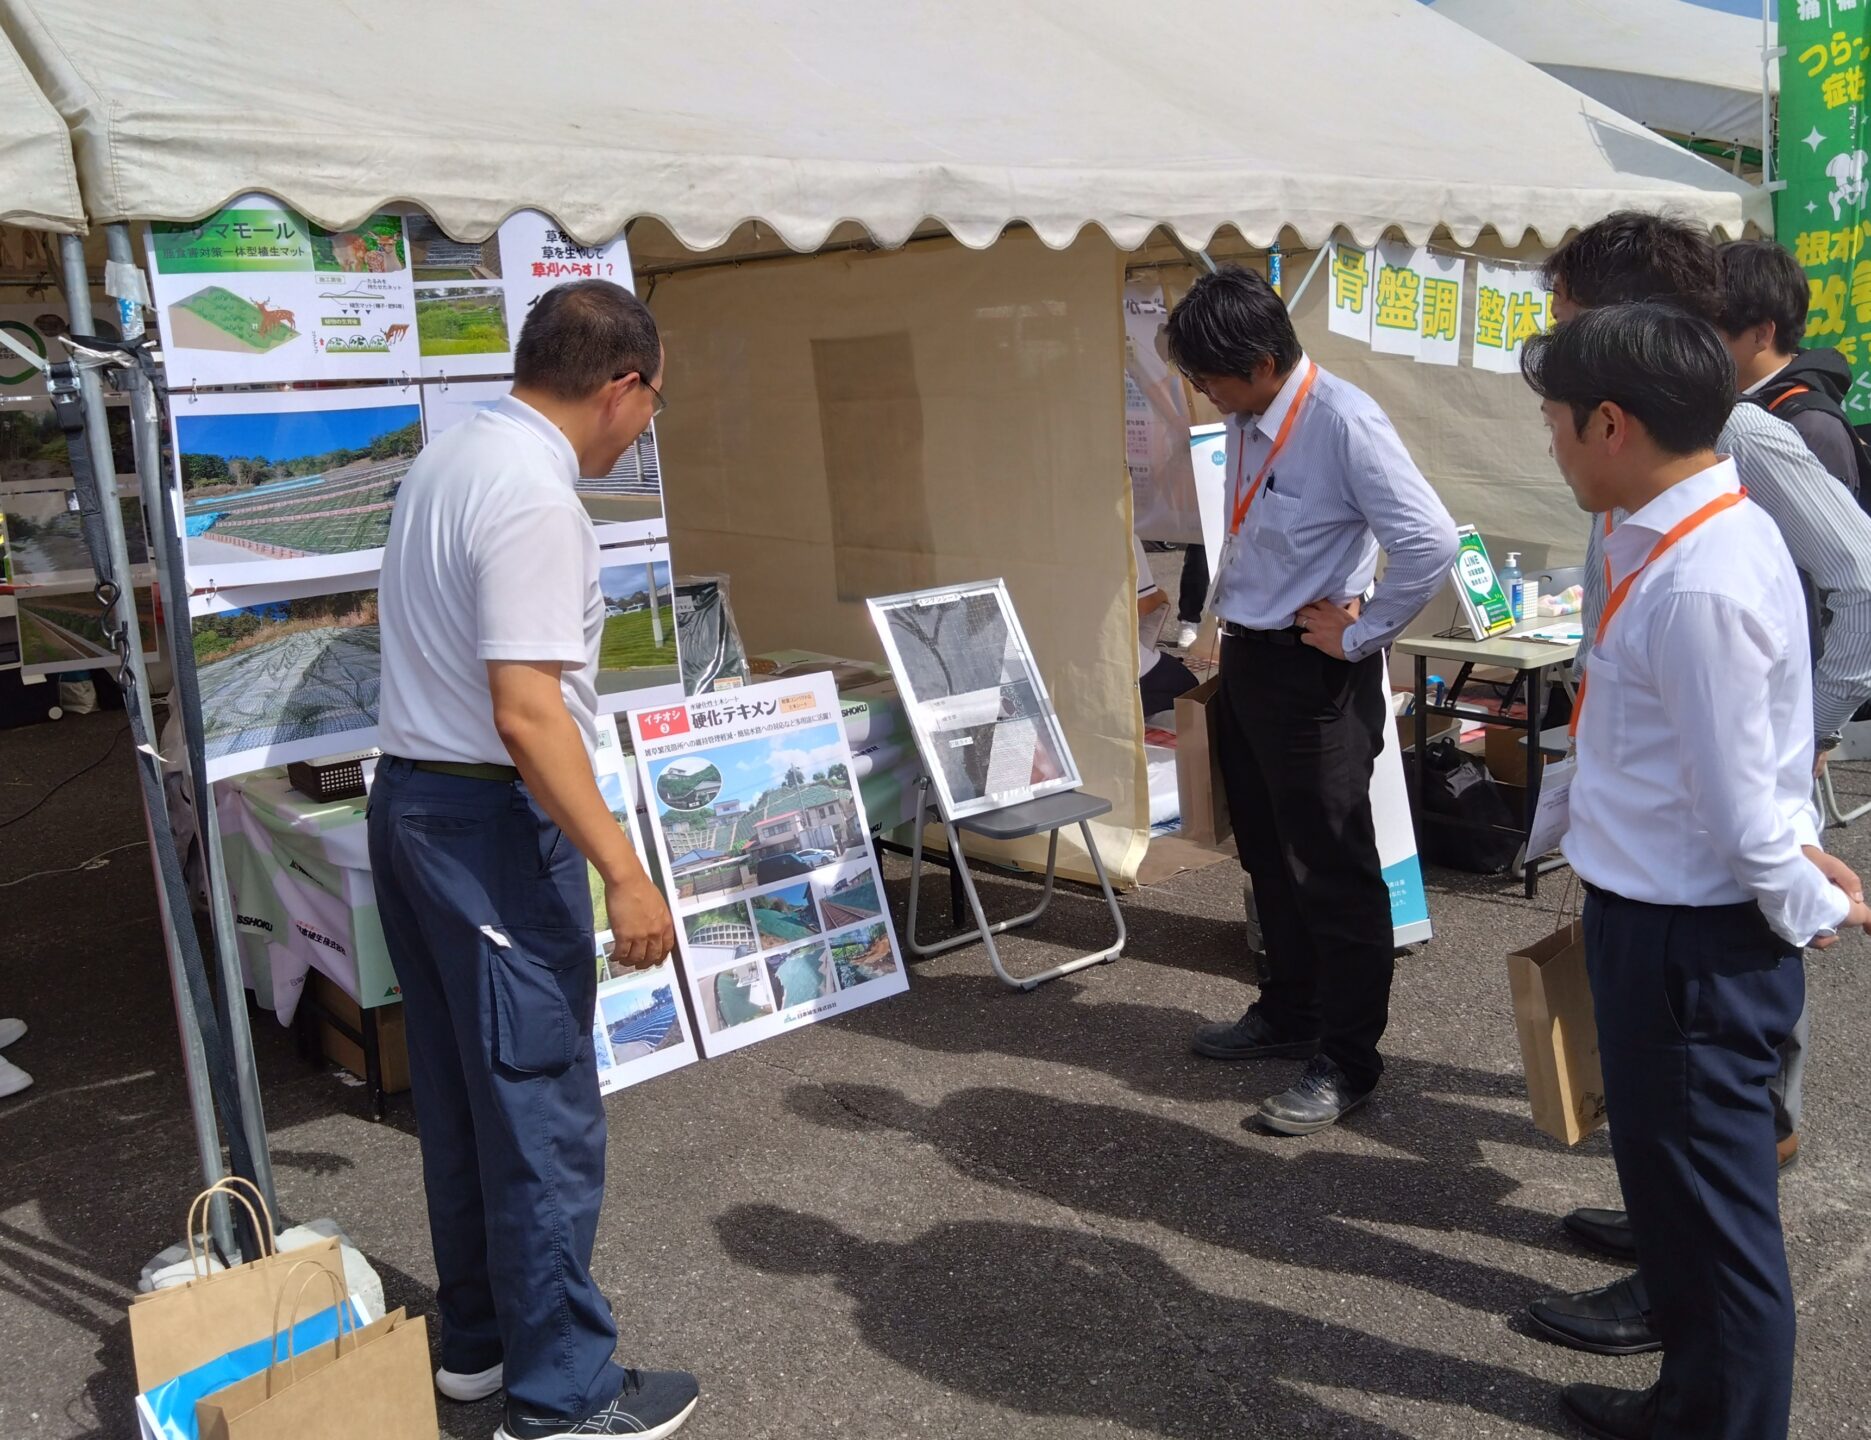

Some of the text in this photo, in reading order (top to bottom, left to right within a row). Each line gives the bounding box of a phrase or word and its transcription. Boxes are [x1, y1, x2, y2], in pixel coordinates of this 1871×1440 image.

[541, 246, 604, 259] 草を生やして
[644, 710, 681, 725] イチオシ
[692, 698, 777, 729] 硬化テキメン
